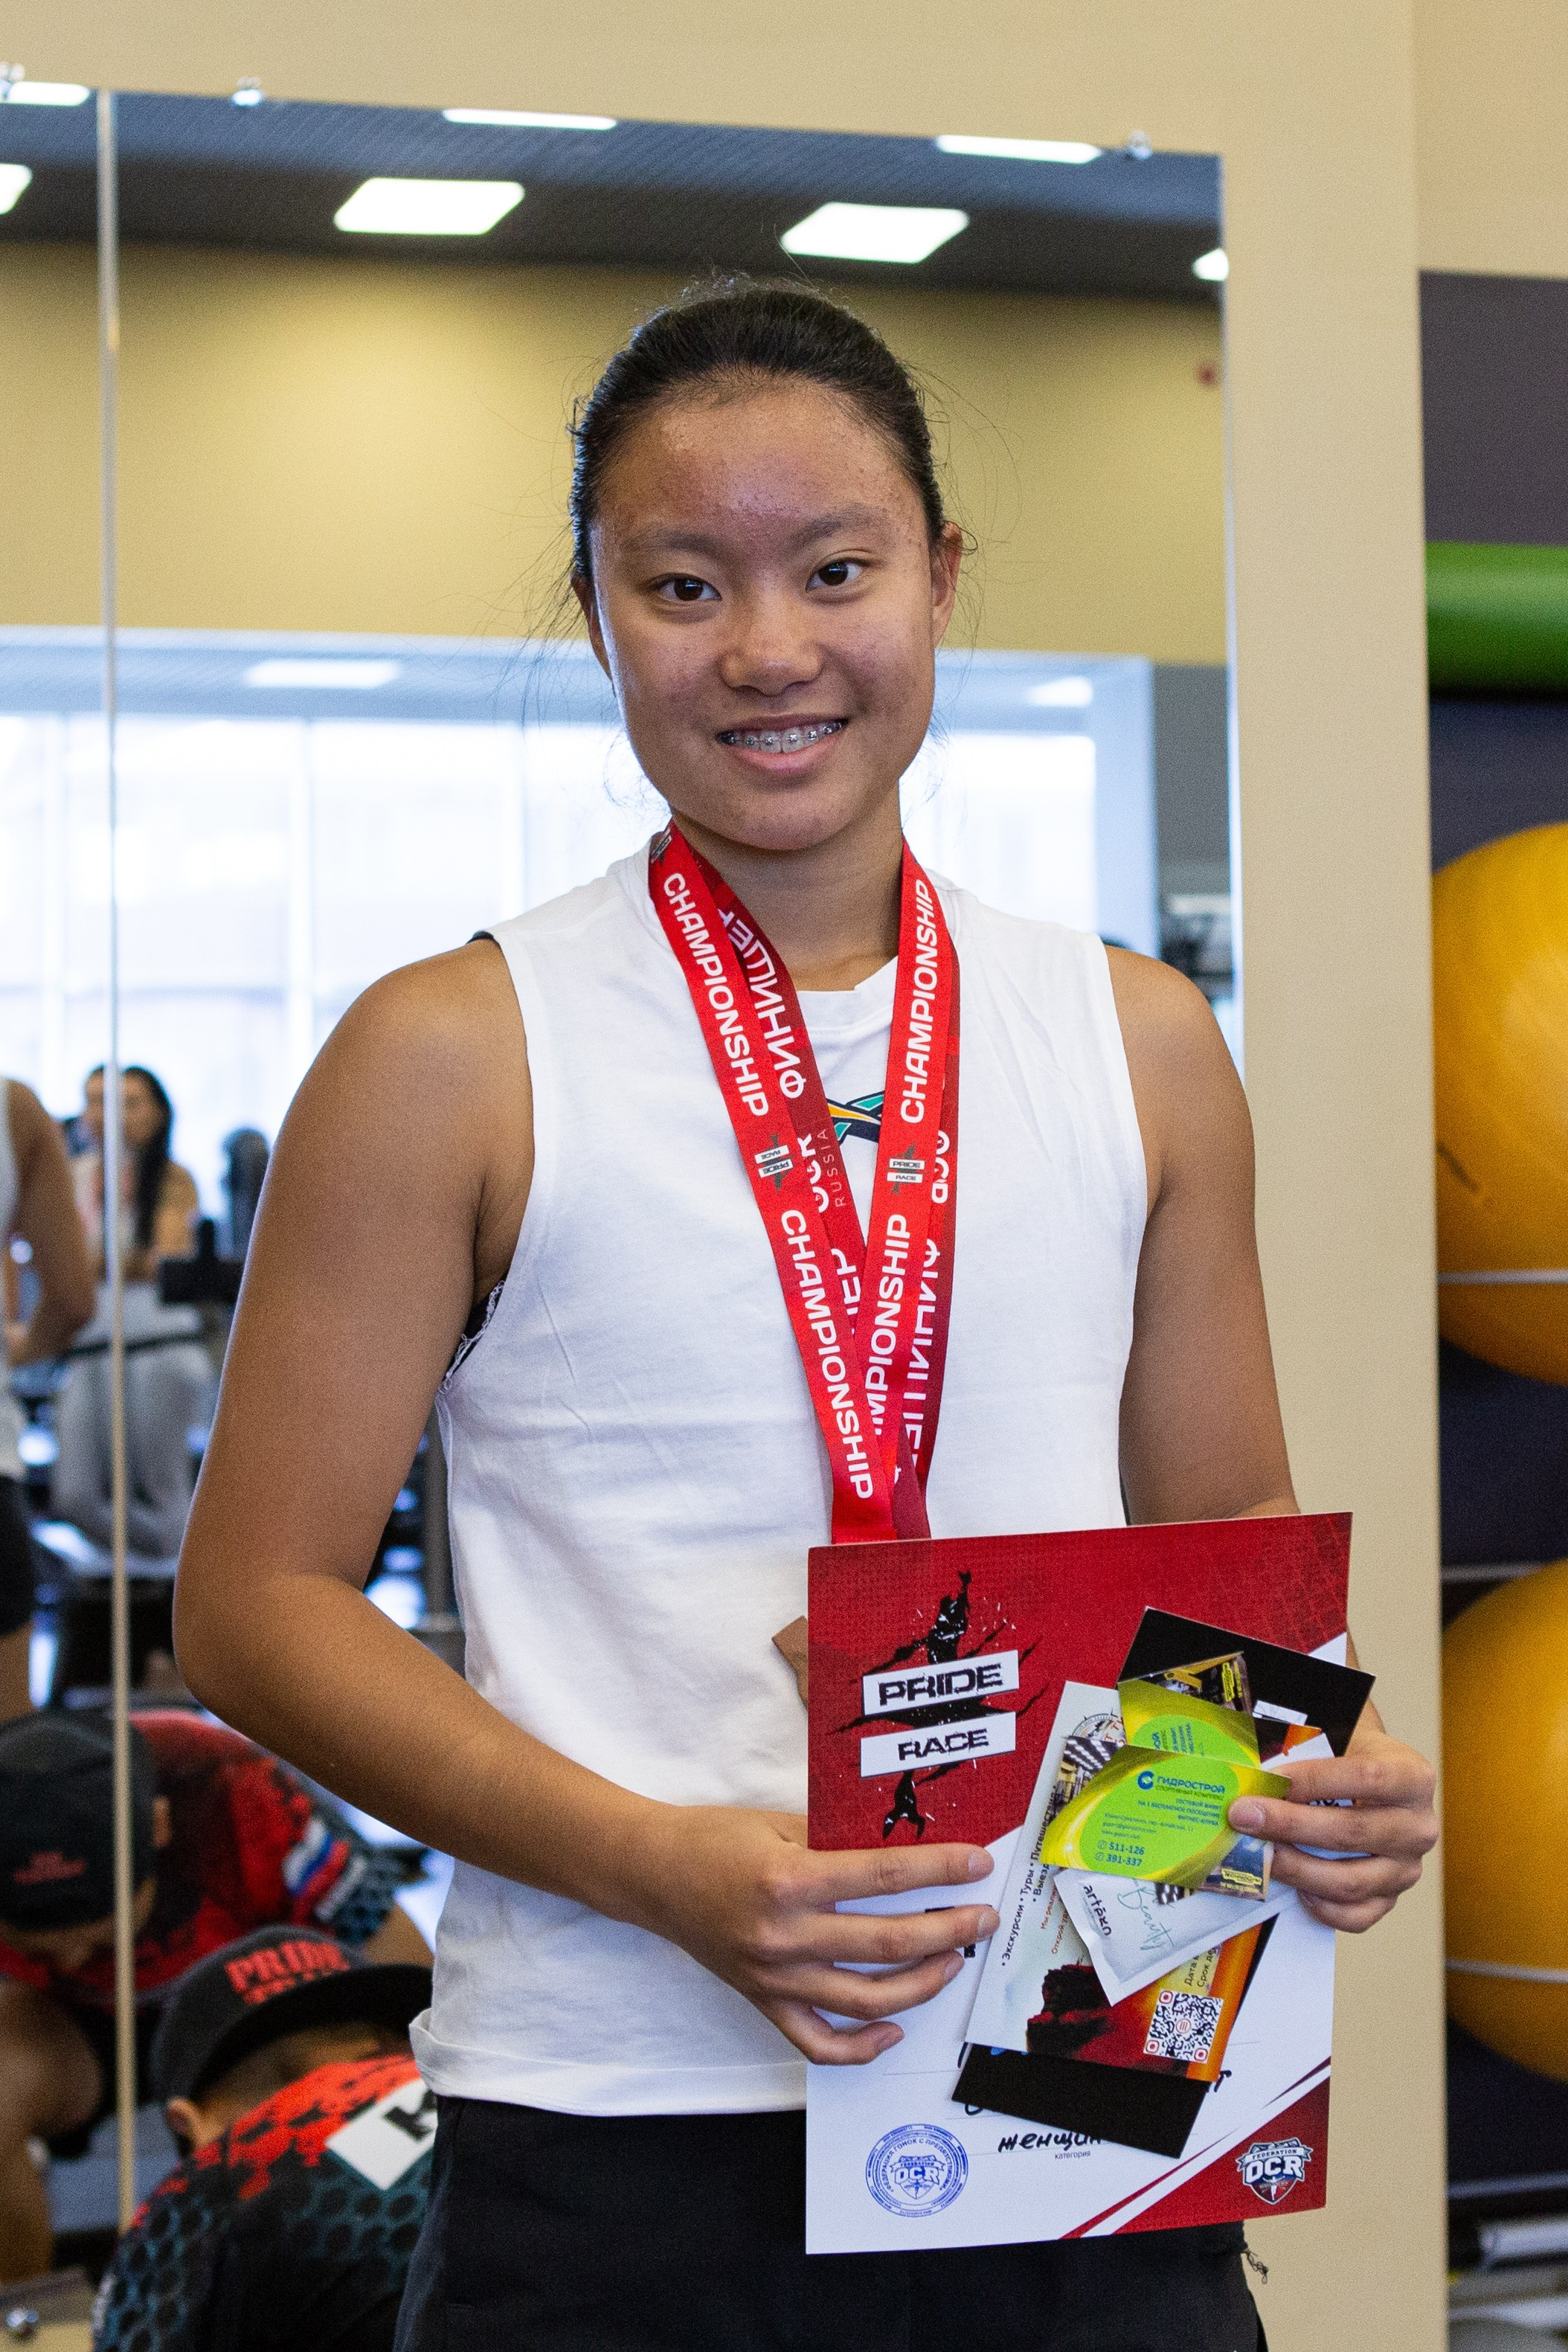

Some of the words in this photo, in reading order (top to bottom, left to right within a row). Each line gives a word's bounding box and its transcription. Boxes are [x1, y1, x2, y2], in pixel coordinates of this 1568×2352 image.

[663, 873, 769, 1116] CHAMPIONSHIP
[901, 879, 937, 1123] CHAMPIONSHIP
[762, 1160, 790, 1175] PRIDE
[817, 1129, 846, 1207] RUSSIA
[864, 1214, 910, 1435] MPIONSHIP
[781, 1209, 873, 1499] CHAMPIONSHIP
[878, 1662, 1003, 1706] PRIDE
[898, 1728, 989, 1761] RACE
[1157, 1776, 1225, 1793] ГИДРОСТРОЙ
[1107, 1853, 1143, 1867] 391-337
[1109, 1842, 1145, 1856] 511-126
[1005, 1904, 1024, 1960] Экскурсии
[1020, 1869, 1034, 1895] Туры
[1051, 1924, 1064, 1954] Открой
[1184, 1962, 1198, 1986] Дата
[1197, 1964, 1210, 1987] Срок
[893, 2139, 916, 2152] ГОНОК
[1054, 2150, 1091, 2160] категория
[1252, 2149, 1297, 2159] FEDERATION
[895, 2166, 939, 2185] OCR
[1245, 2156, 1303, 2184] OCR
